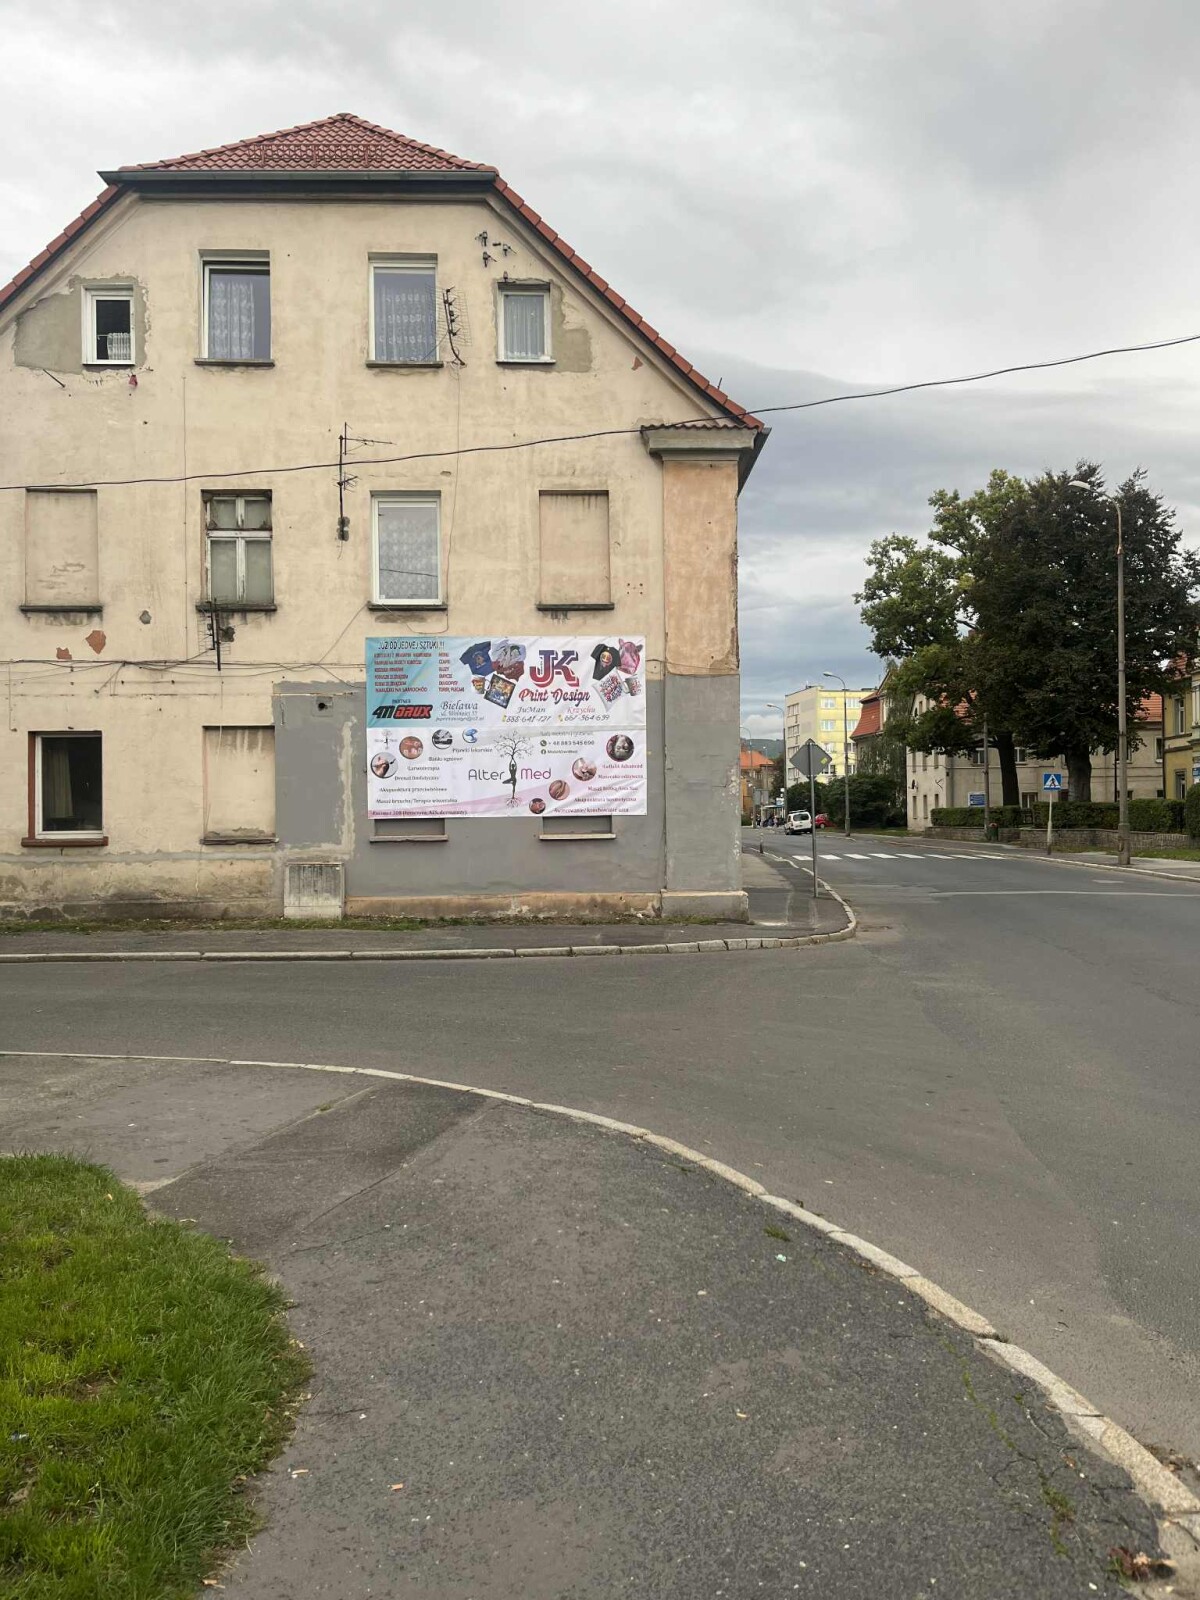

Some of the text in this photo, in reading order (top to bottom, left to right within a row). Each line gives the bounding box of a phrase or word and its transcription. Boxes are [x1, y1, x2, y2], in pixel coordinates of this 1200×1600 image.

[398, 641, 417, 649] JEDNEJ
[420, 641, 438, 650] SZTUKI
[530, 650, 579, 688] JK
[519, 688, 590, 707] Print Design
[441, 700, 478, 710] Bielawa
[468, 768, 551, 780] Alter Med
